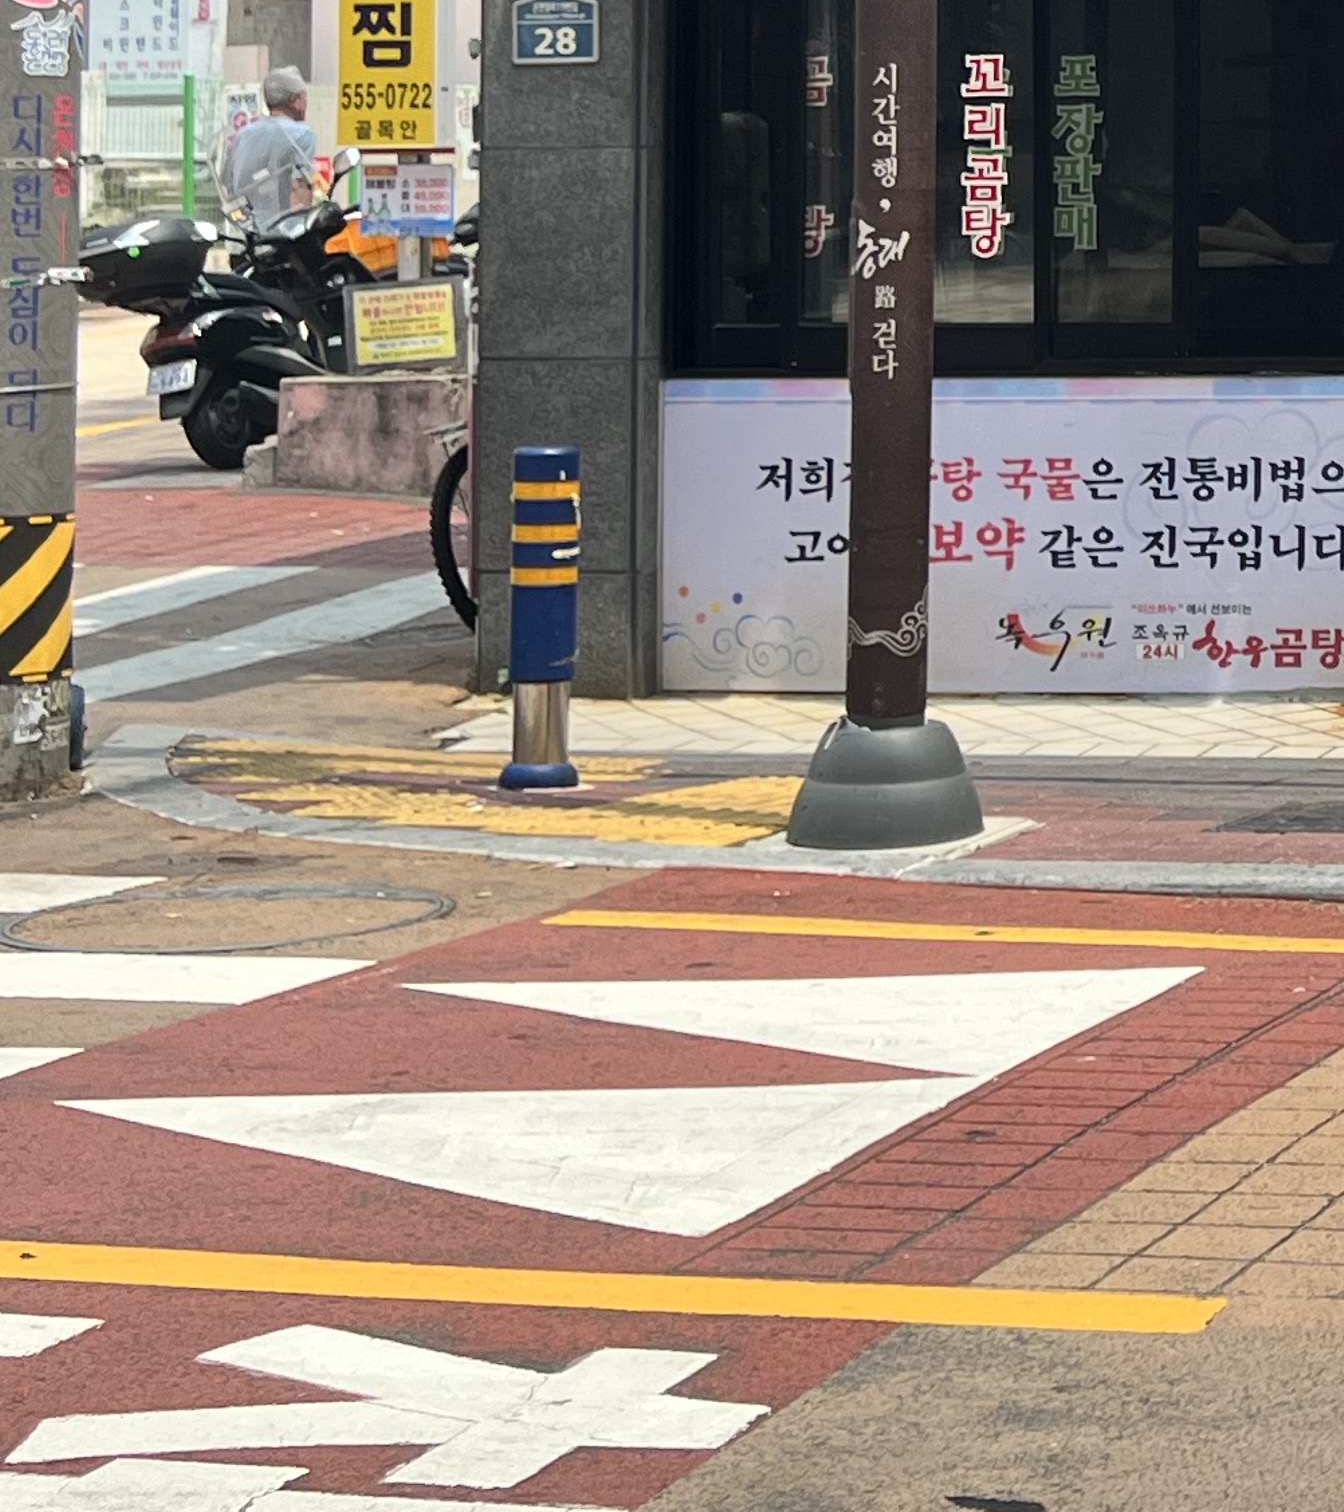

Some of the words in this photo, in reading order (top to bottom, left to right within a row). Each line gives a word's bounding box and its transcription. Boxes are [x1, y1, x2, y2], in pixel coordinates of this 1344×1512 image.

[534, 26, 577, 56] 28
[340, 82, 433, 112] 555-0722
[353, 119, 419, 142] 골목안
[960, 54, 1011, 259] 꼬리곰탕
[1051, 54, 1104, 251] 포장판매
[872, 317, 899, 380] 걷다
[756, 456, 852, 503] 저희
[997, 456, 1124, 503] 국물은
[1039, 523, 1124, 570] 같은
[1131, 623, 1190, 642] 조옥규
[1142, 644, 1179, 660] 24시
